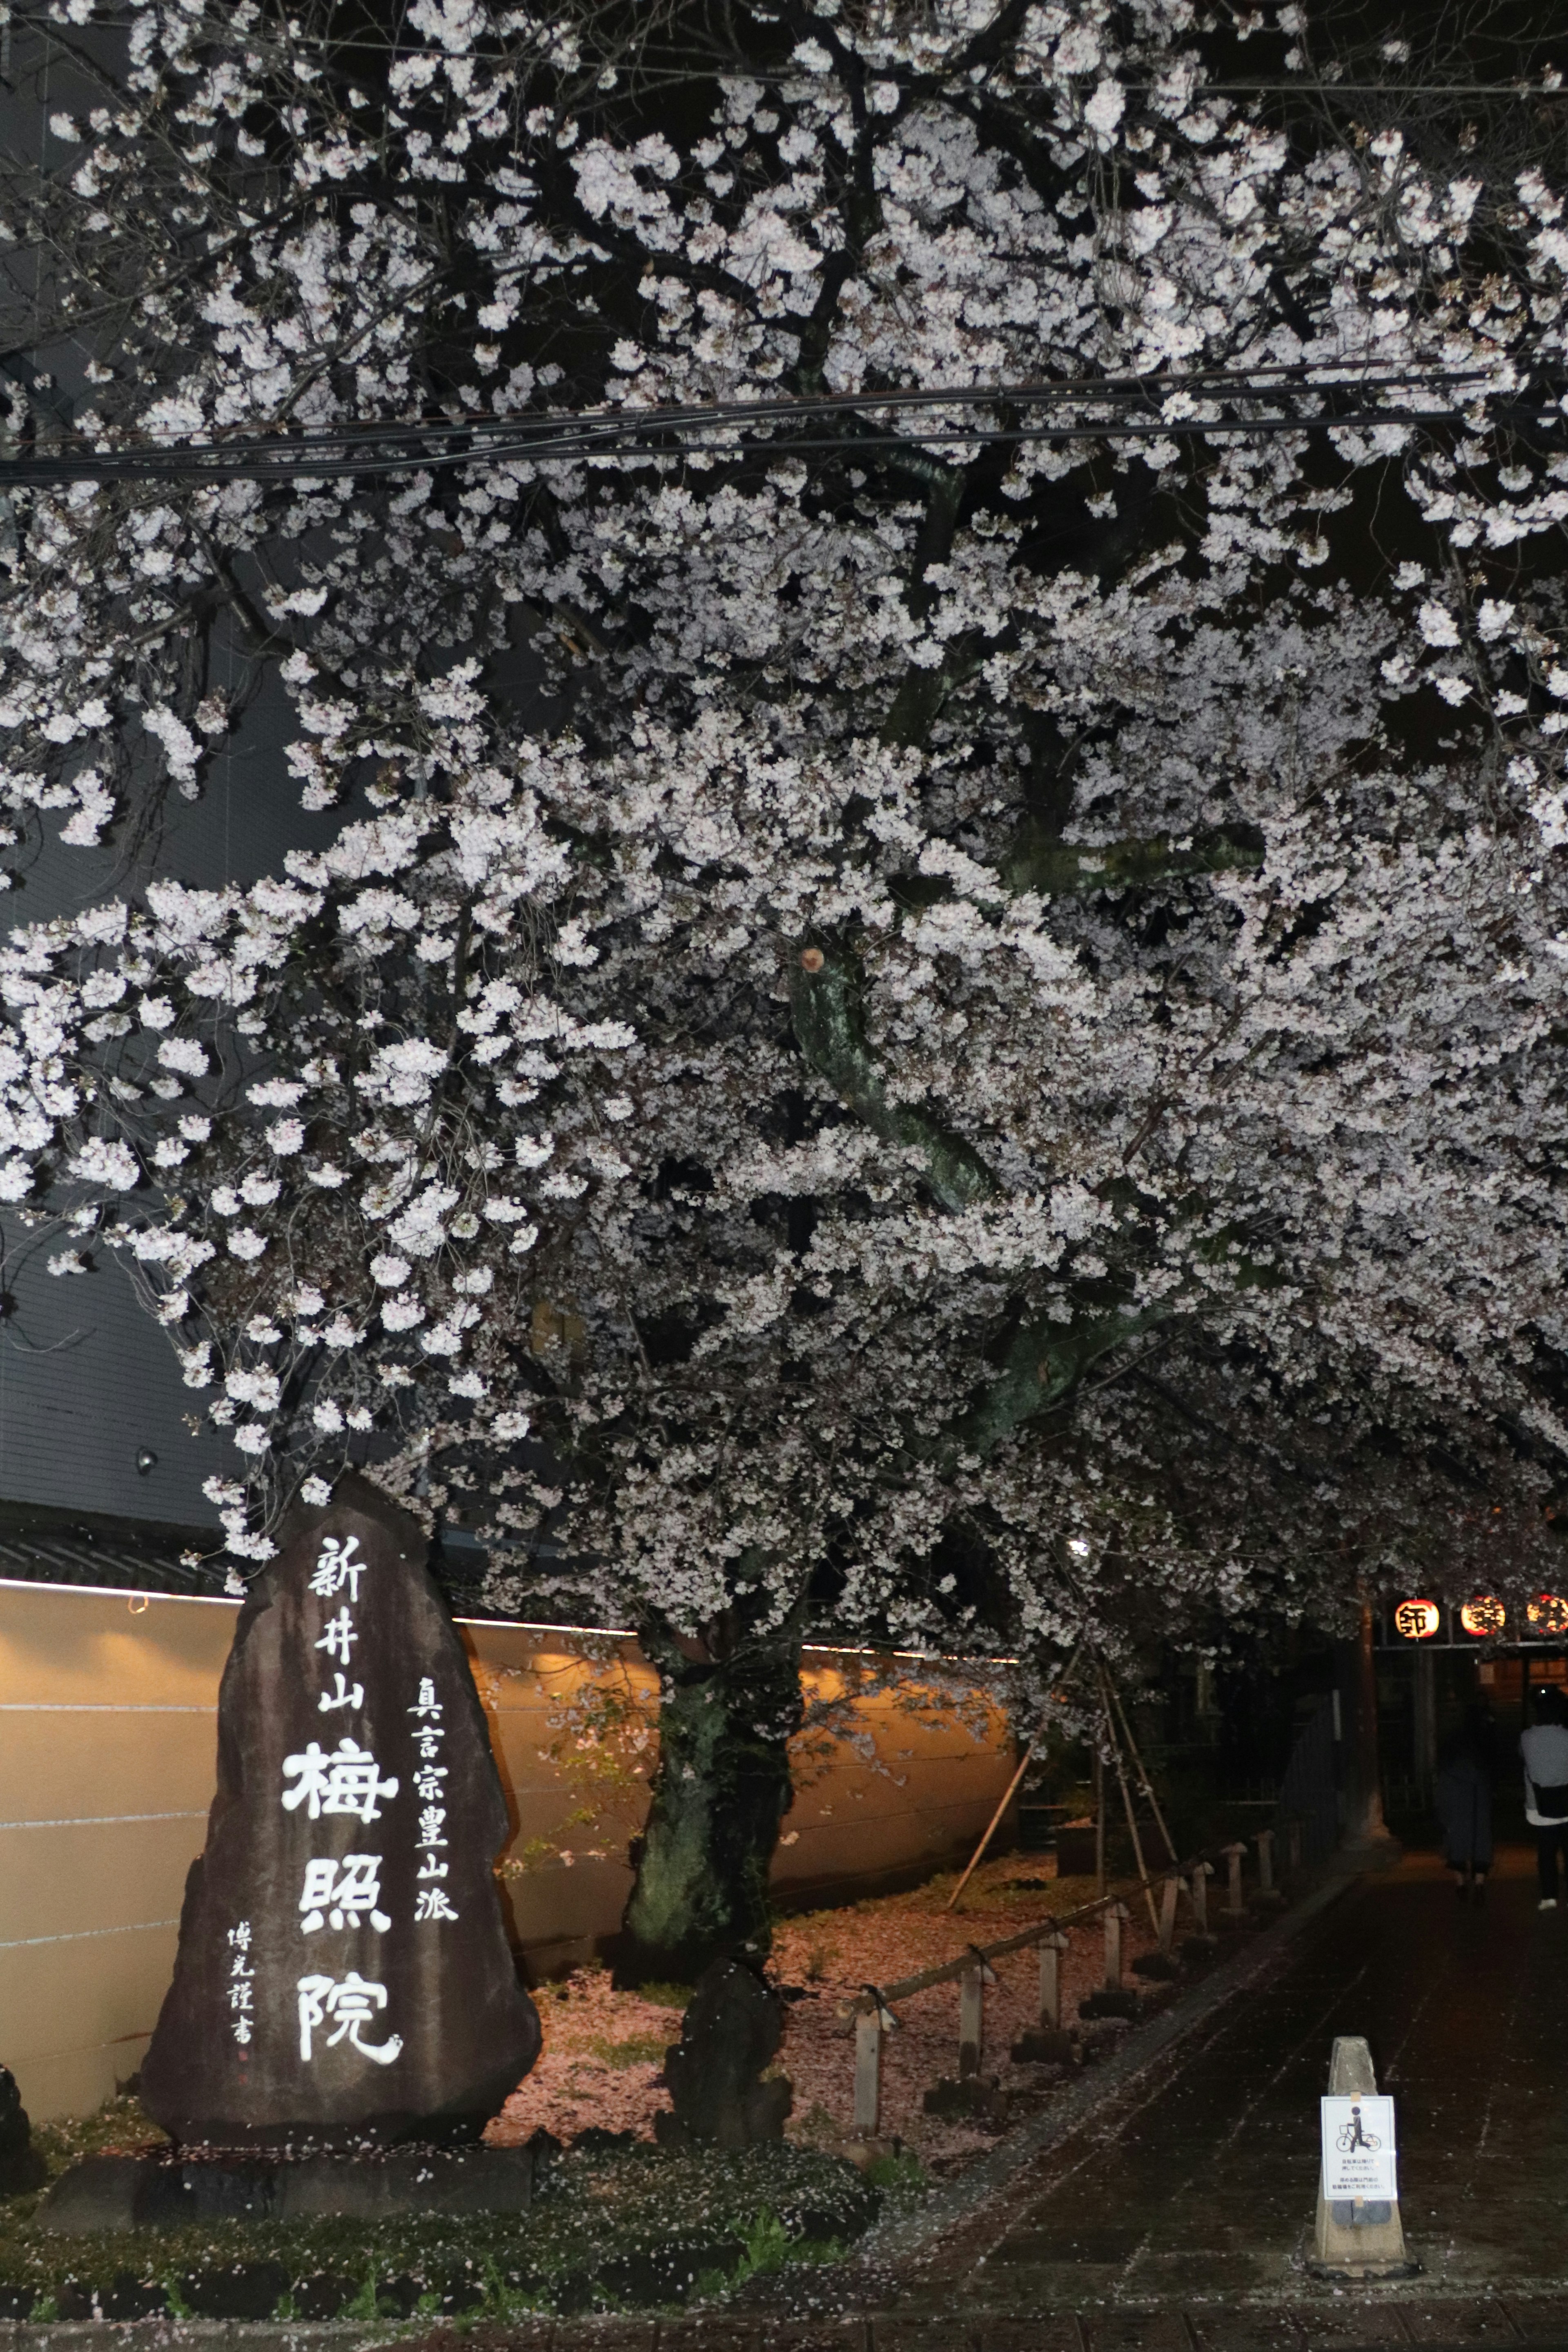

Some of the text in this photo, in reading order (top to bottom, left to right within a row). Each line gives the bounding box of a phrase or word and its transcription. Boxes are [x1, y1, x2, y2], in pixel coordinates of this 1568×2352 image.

[281, 1536, 404, 2065] 新井山梅照院
